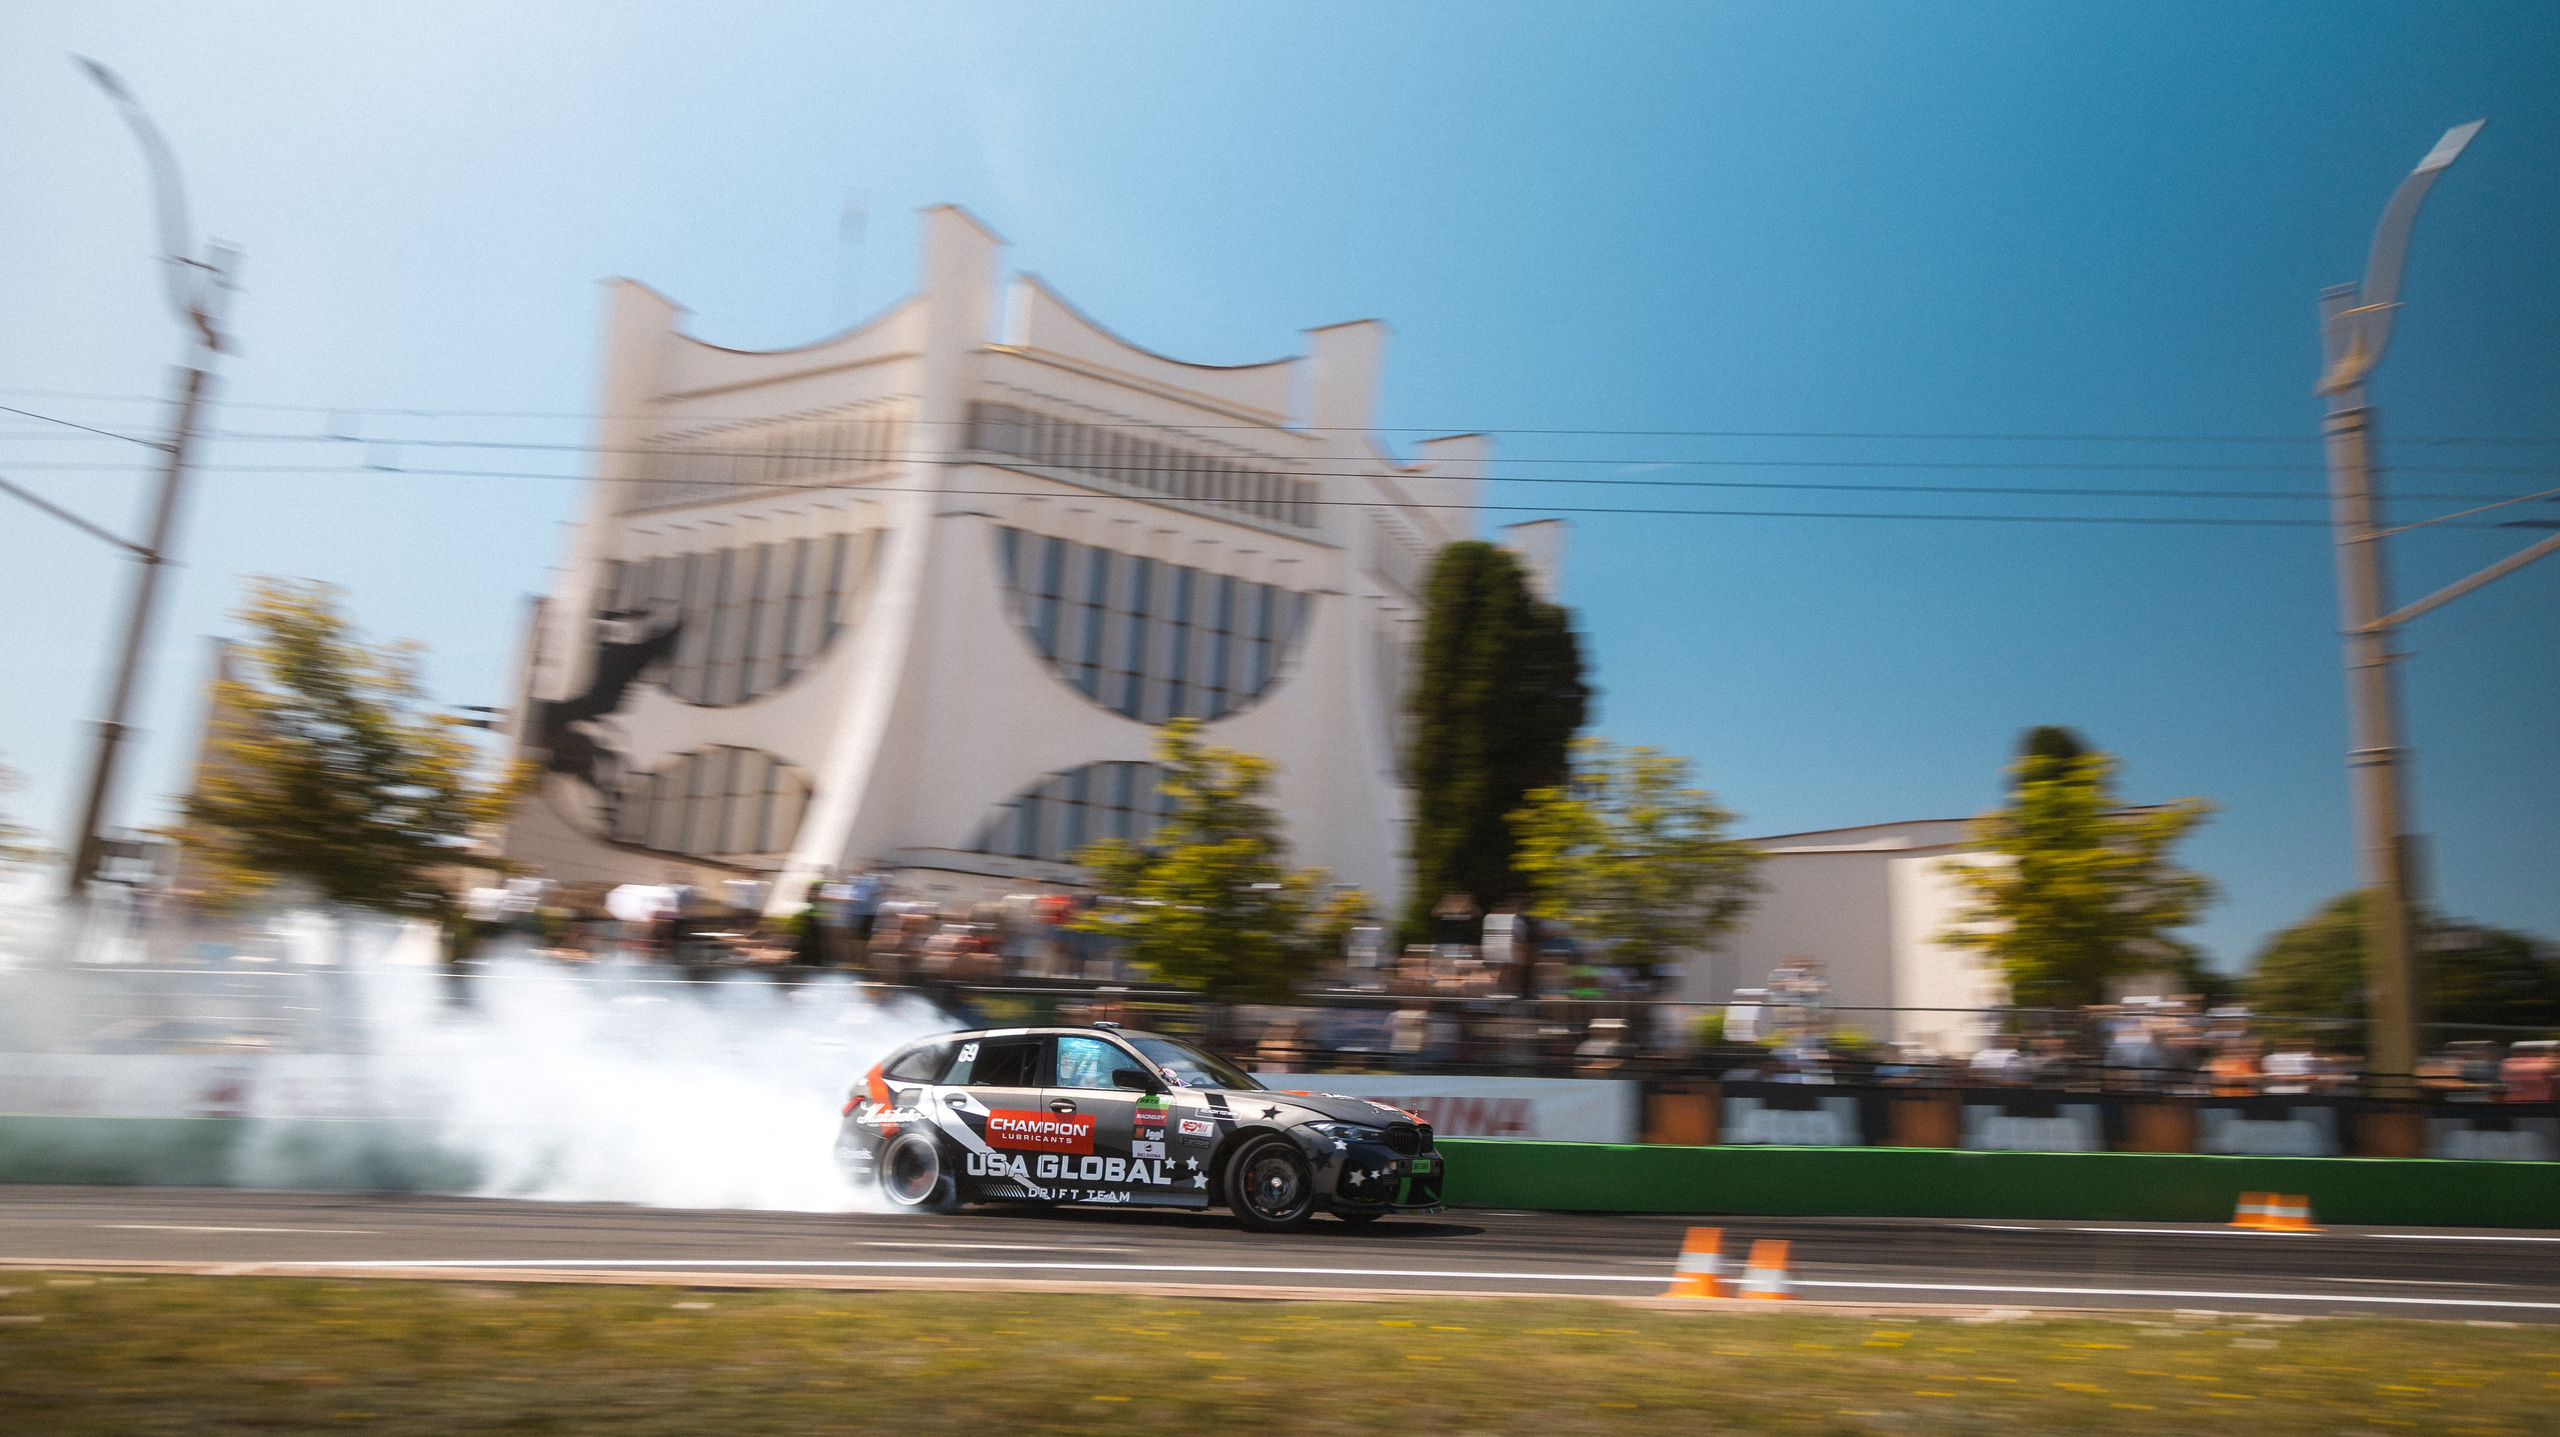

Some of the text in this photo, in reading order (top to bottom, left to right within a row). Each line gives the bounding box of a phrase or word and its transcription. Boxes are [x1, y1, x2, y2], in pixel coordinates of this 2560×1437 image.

[957, 1043, 979, 1062] 69
[990, 1118, 1087, 1137] CHAMPION
[1001, 1133, 1073, 1145] LUBRICANTS
[967, 1152, 1172, 1185] USA GLOBAL
[1027, 1187, 1131, 1203] DRIFT TEAM
